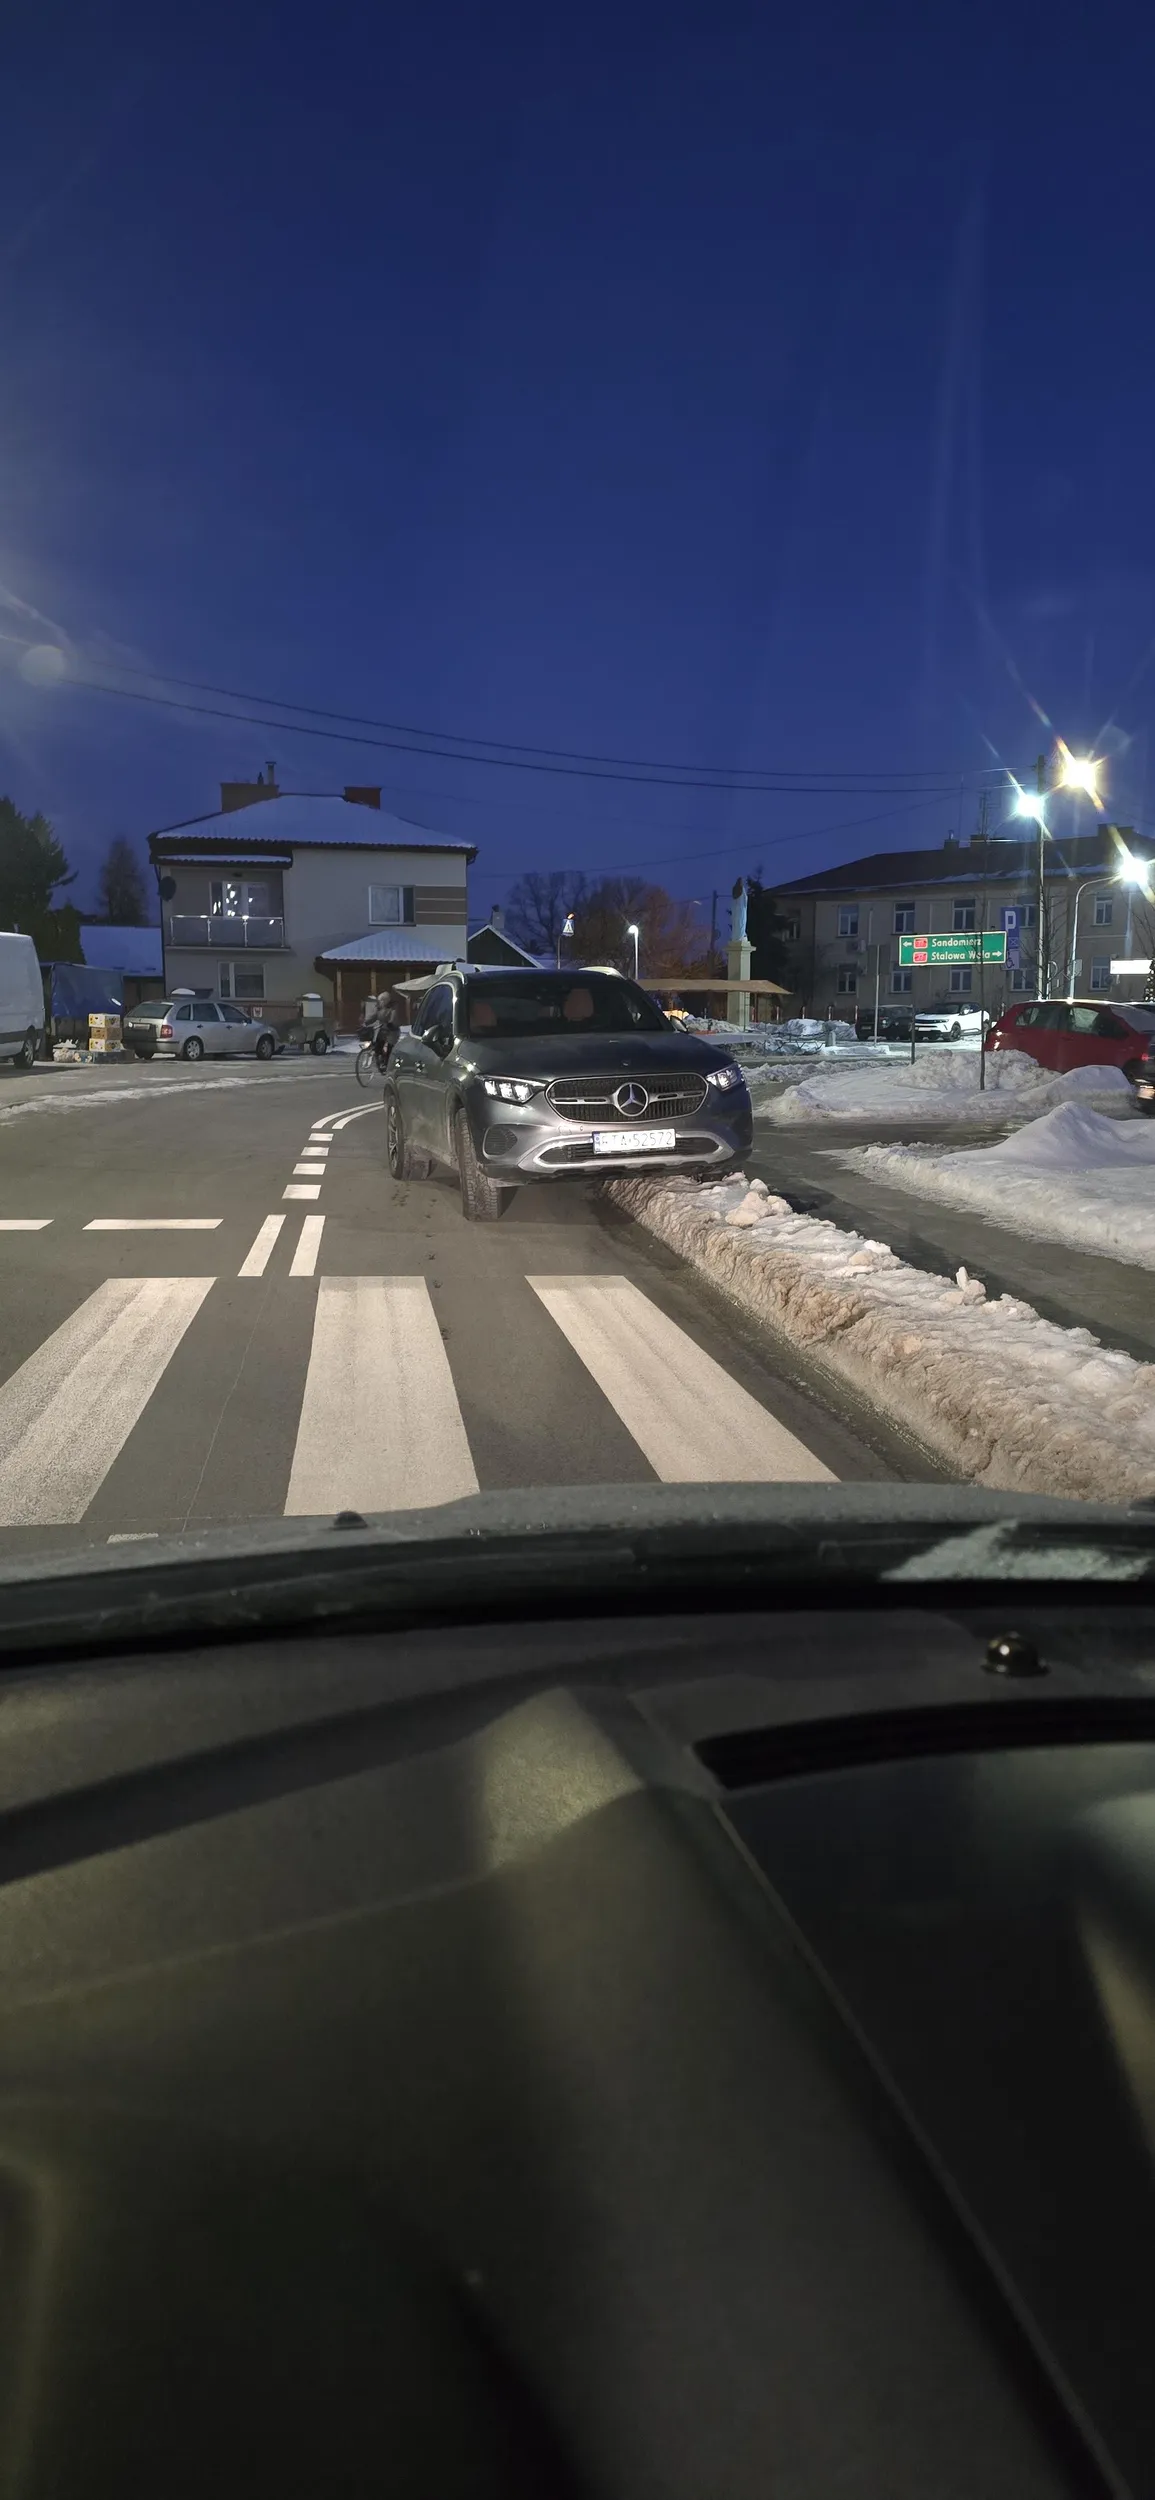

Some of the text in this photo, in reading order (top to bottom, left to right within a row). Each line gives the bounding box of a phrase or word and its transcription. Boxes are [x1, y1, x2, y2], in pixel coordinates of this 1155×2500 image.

[1005, 911, 1016, 931] P
[932, 937, 981, 948] Sandomierz
[931, 951, 965, 961] Stalowa
[968, 950, 990, 960] Wola
[633, 1131, 673, 1147] 52572
